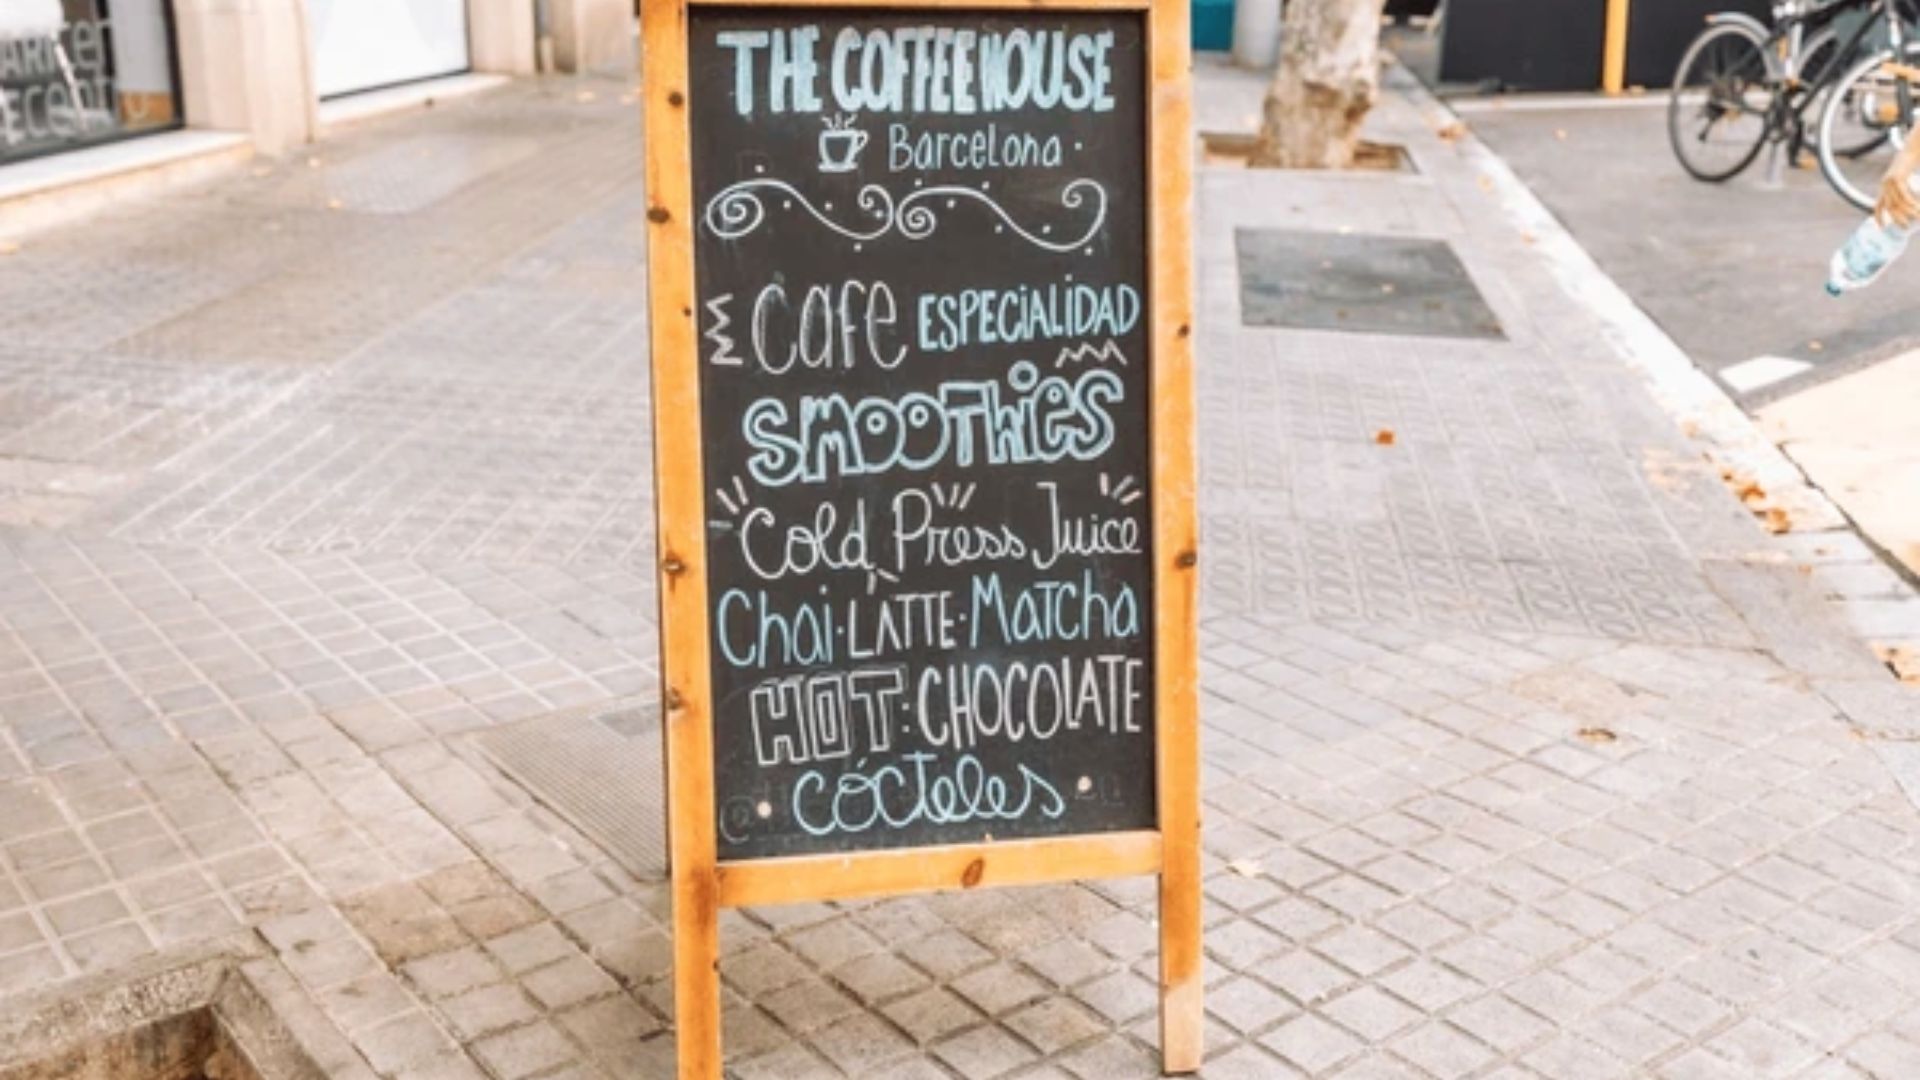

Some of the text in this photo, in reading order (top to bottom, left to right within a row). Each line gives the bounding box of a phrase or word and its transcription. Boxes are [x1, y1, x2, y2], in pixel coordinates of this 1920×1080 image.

[717, 25, 824, 116] THE
[888, 123, 1062, 171] Barcelona
[740, 482, 1143, 580] Cold Press Juice
[717, 584, 834, 668] Chai
[848, 591, 957, 659] LATTE
[917, 656, 1144, 750] CHOCOLATE
